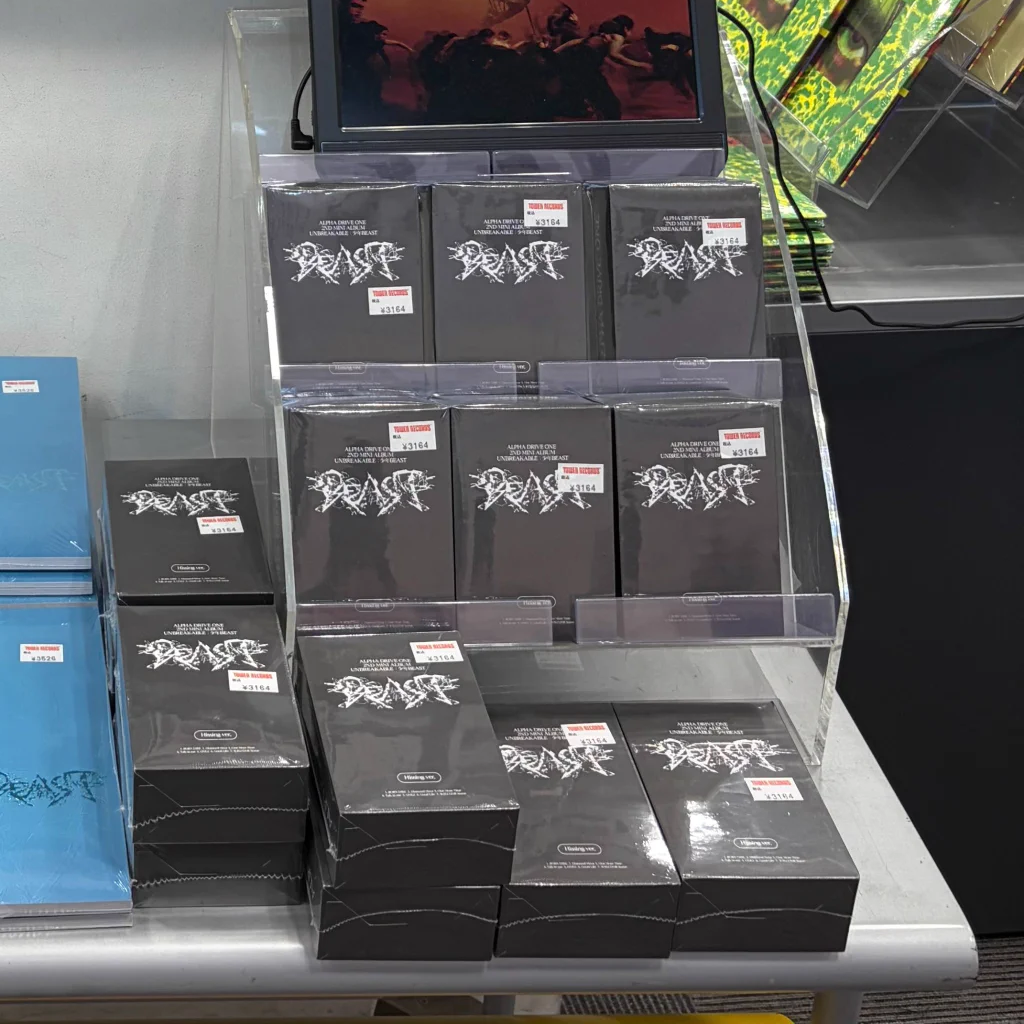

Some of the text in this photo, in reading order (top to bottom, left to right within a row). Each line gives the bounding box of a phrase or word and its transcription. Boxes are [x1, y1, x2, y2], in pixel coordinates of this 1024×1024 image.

[282, 241, 405, 285] BEAST
[447, 240, 570, 285] BEAST
[381, 305, 405, 313] ¥3164
[402, 441, 428, 450] ¥3164
[733, 448, 758, 456] ¥3164
[306, 469, 436, 516] BEAST
[632, 464, 761, 511] BEAST
